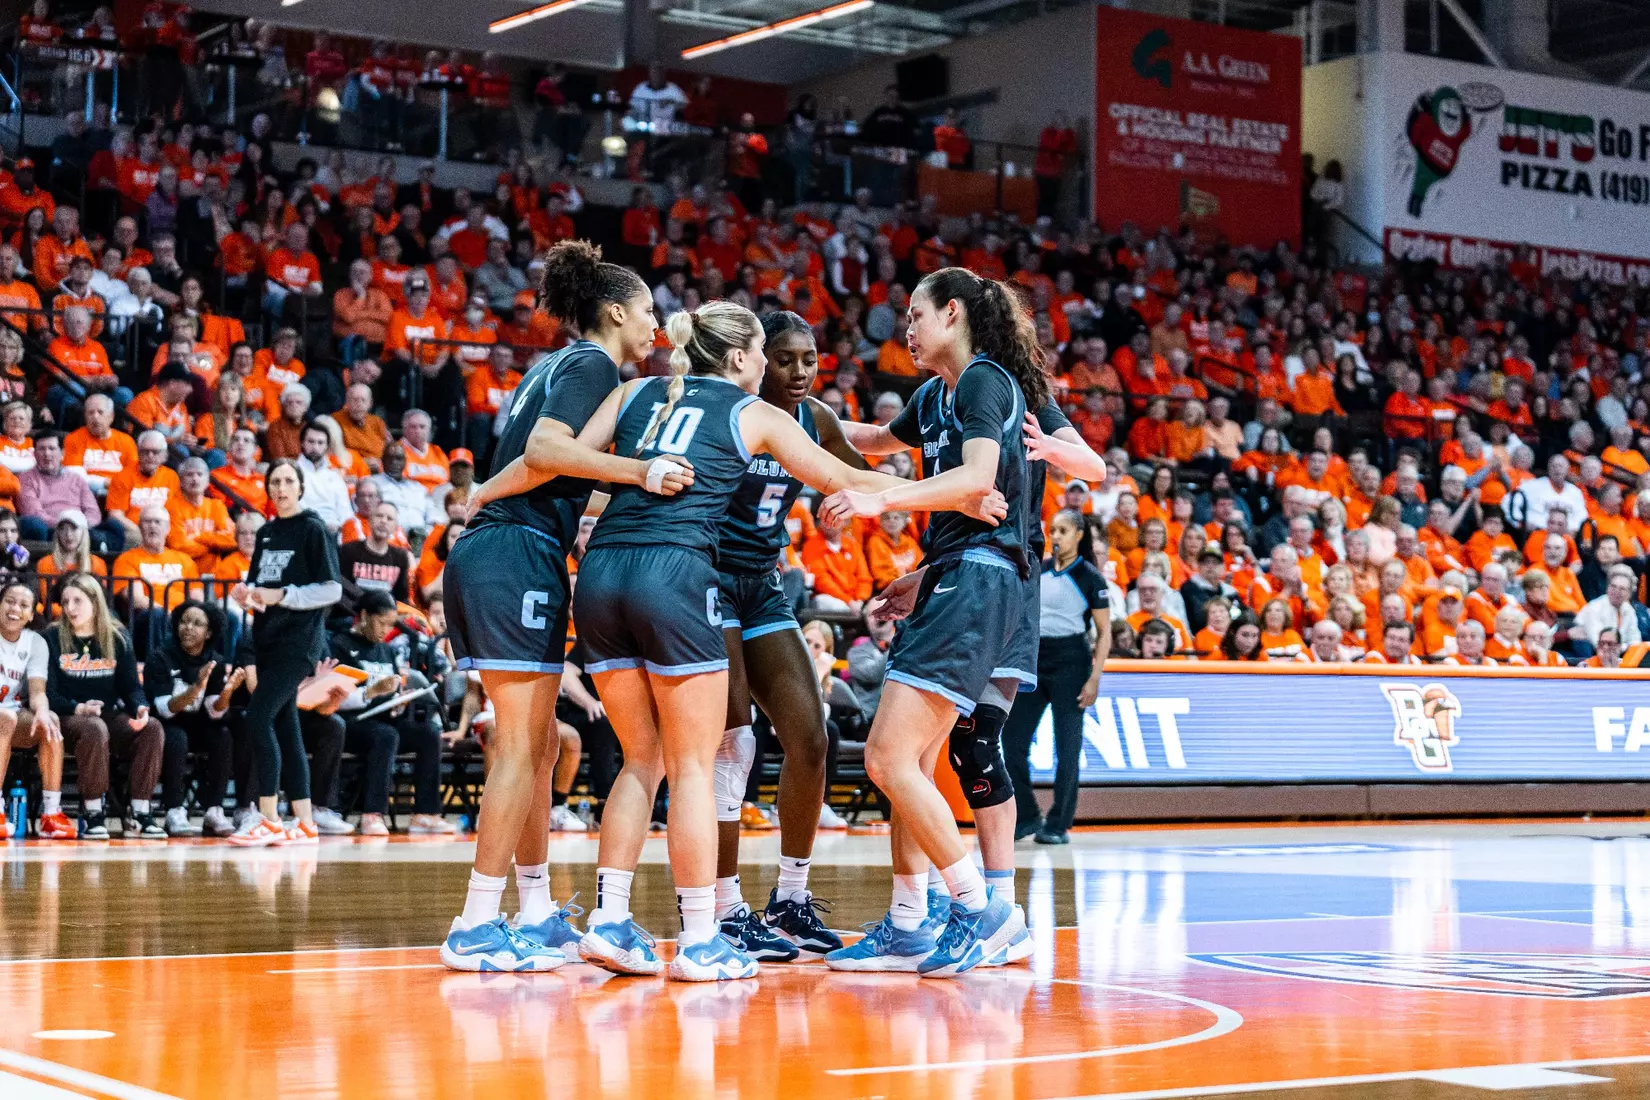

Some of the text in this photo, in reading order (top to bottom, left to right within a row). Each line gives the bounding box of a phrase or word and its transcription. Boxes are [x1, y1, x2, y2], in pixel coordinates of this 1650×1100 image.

[1108, 103, 1289, 141] OFFICIAL REAL ESTATE
[1132, 121, 1205, 144] HOUSING
[1209, 130, 1281, 154] PARTNER
[1501, 160, 1650, 205] PIZZA (419)
[635, 401, 705, 455] 10
[757, 483, 789, 528] 5
[521, 590, 549, 630] C
[706, 587, 723, 627] C
[1028, 697, 1190, 770] NIT
